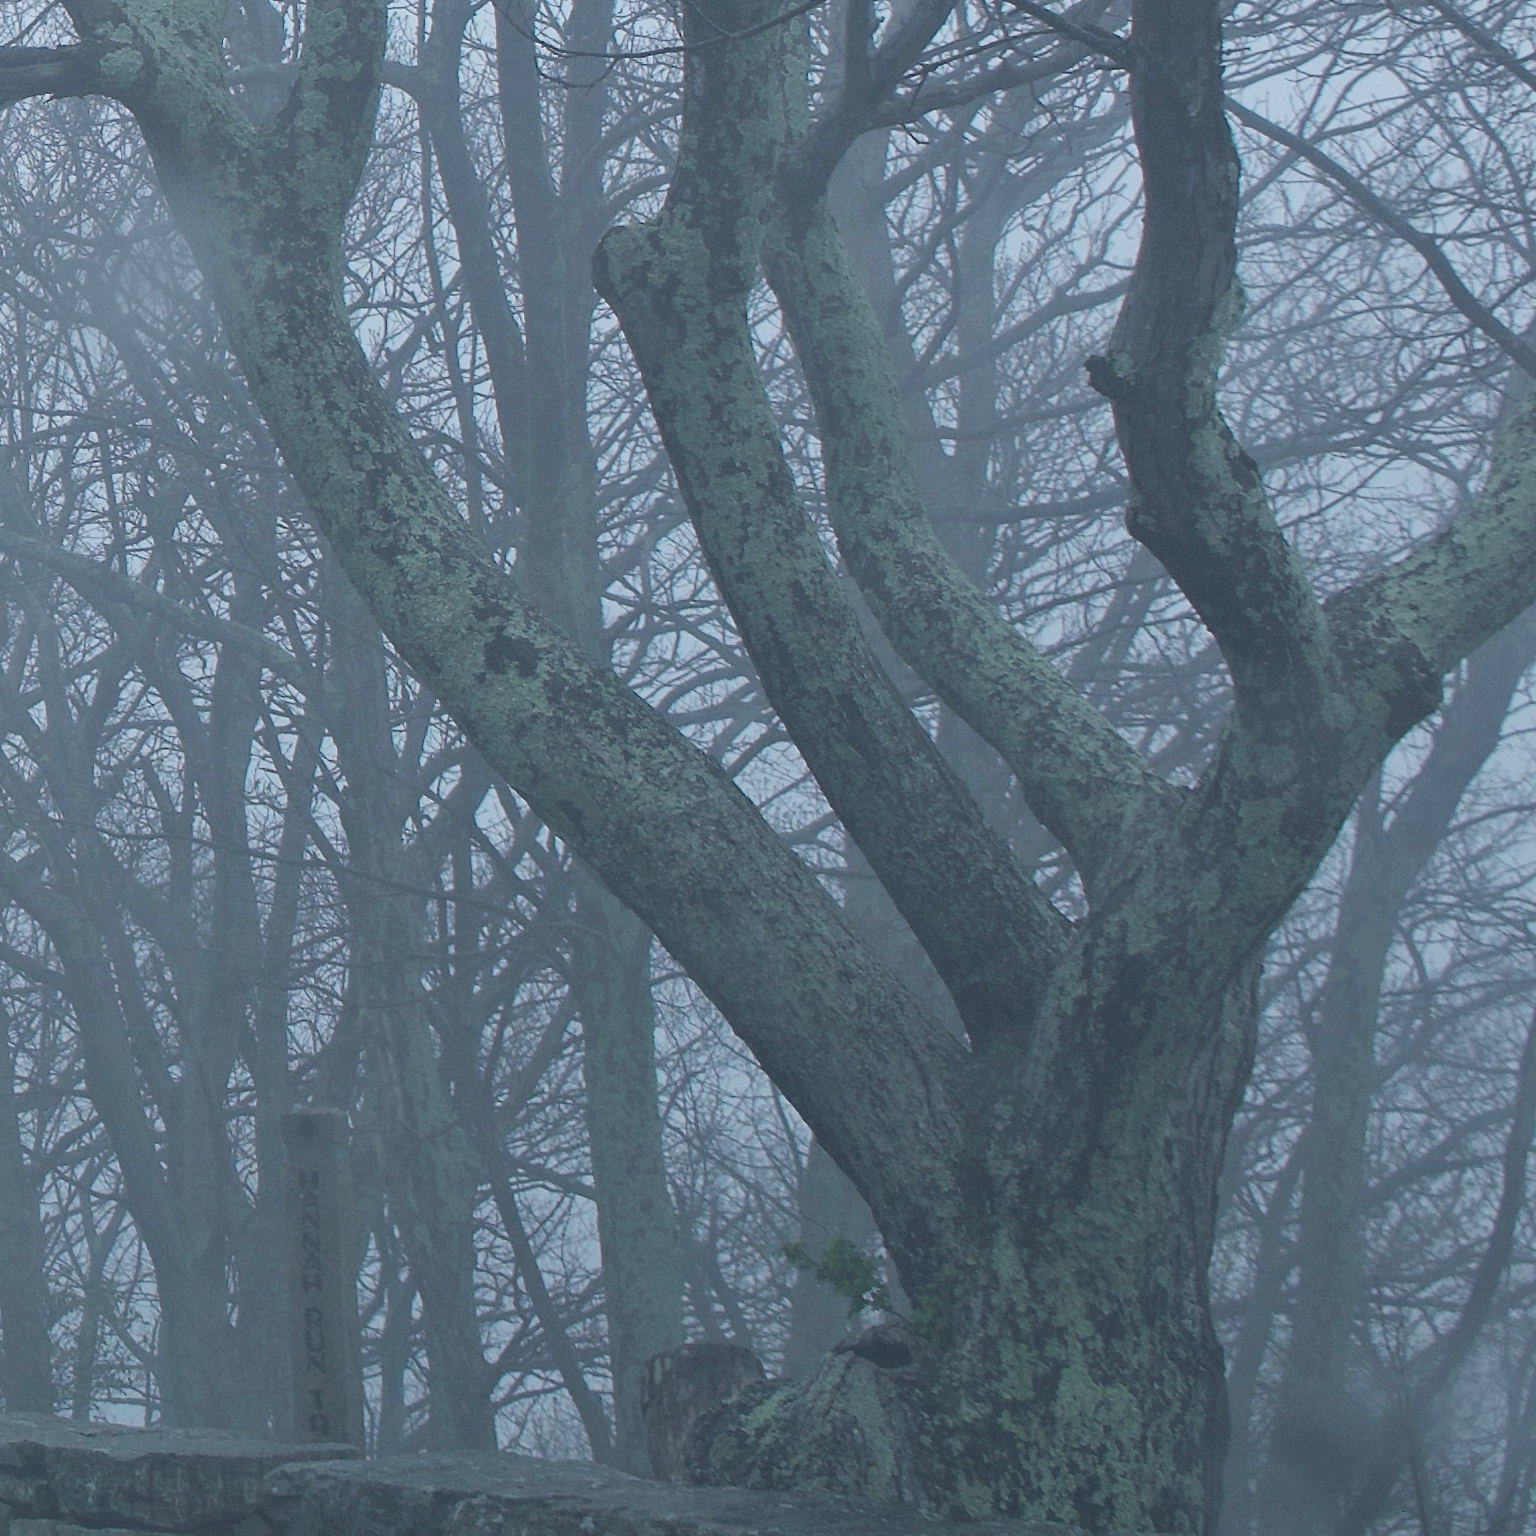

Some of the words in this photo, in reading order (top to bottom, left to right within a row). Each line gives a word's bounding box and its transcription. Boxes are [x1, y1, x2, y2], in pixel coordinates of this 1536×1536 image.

[298, 1169, 324, 1294] HANNAH
[304, 1306, 327, 1375] RUN
[308, 1388, 330, 1437] TR
